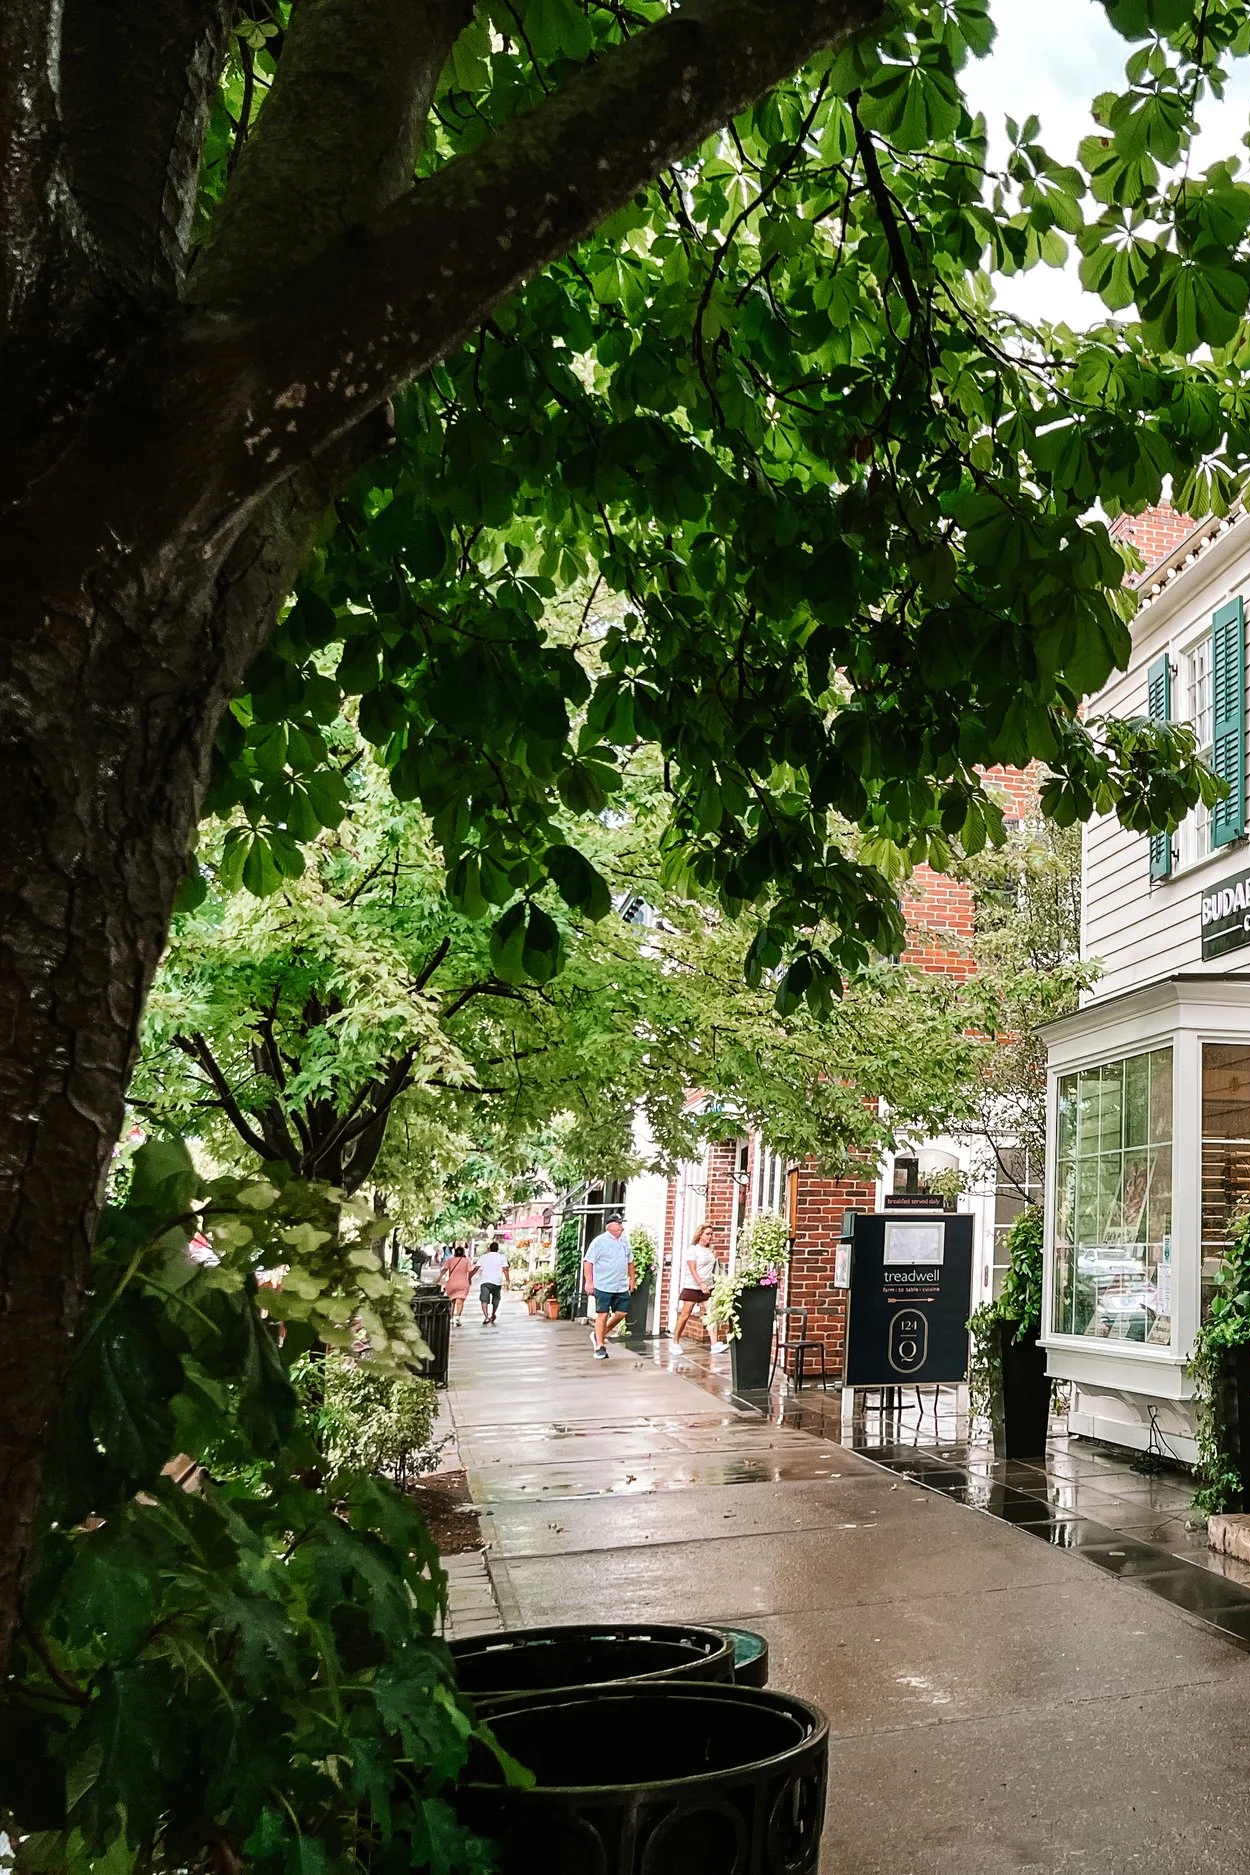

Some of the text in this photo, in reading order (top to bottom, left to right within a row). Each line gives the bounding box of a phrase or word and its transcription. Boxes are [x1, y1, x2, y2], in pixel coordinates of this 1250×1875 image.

[929, 1198, 940, 1206] daily
[883, 1269, 940, 1282] treadwell
[901, 1320, 917, 1331] 124
[898, 1340, 917, 1362] Q
